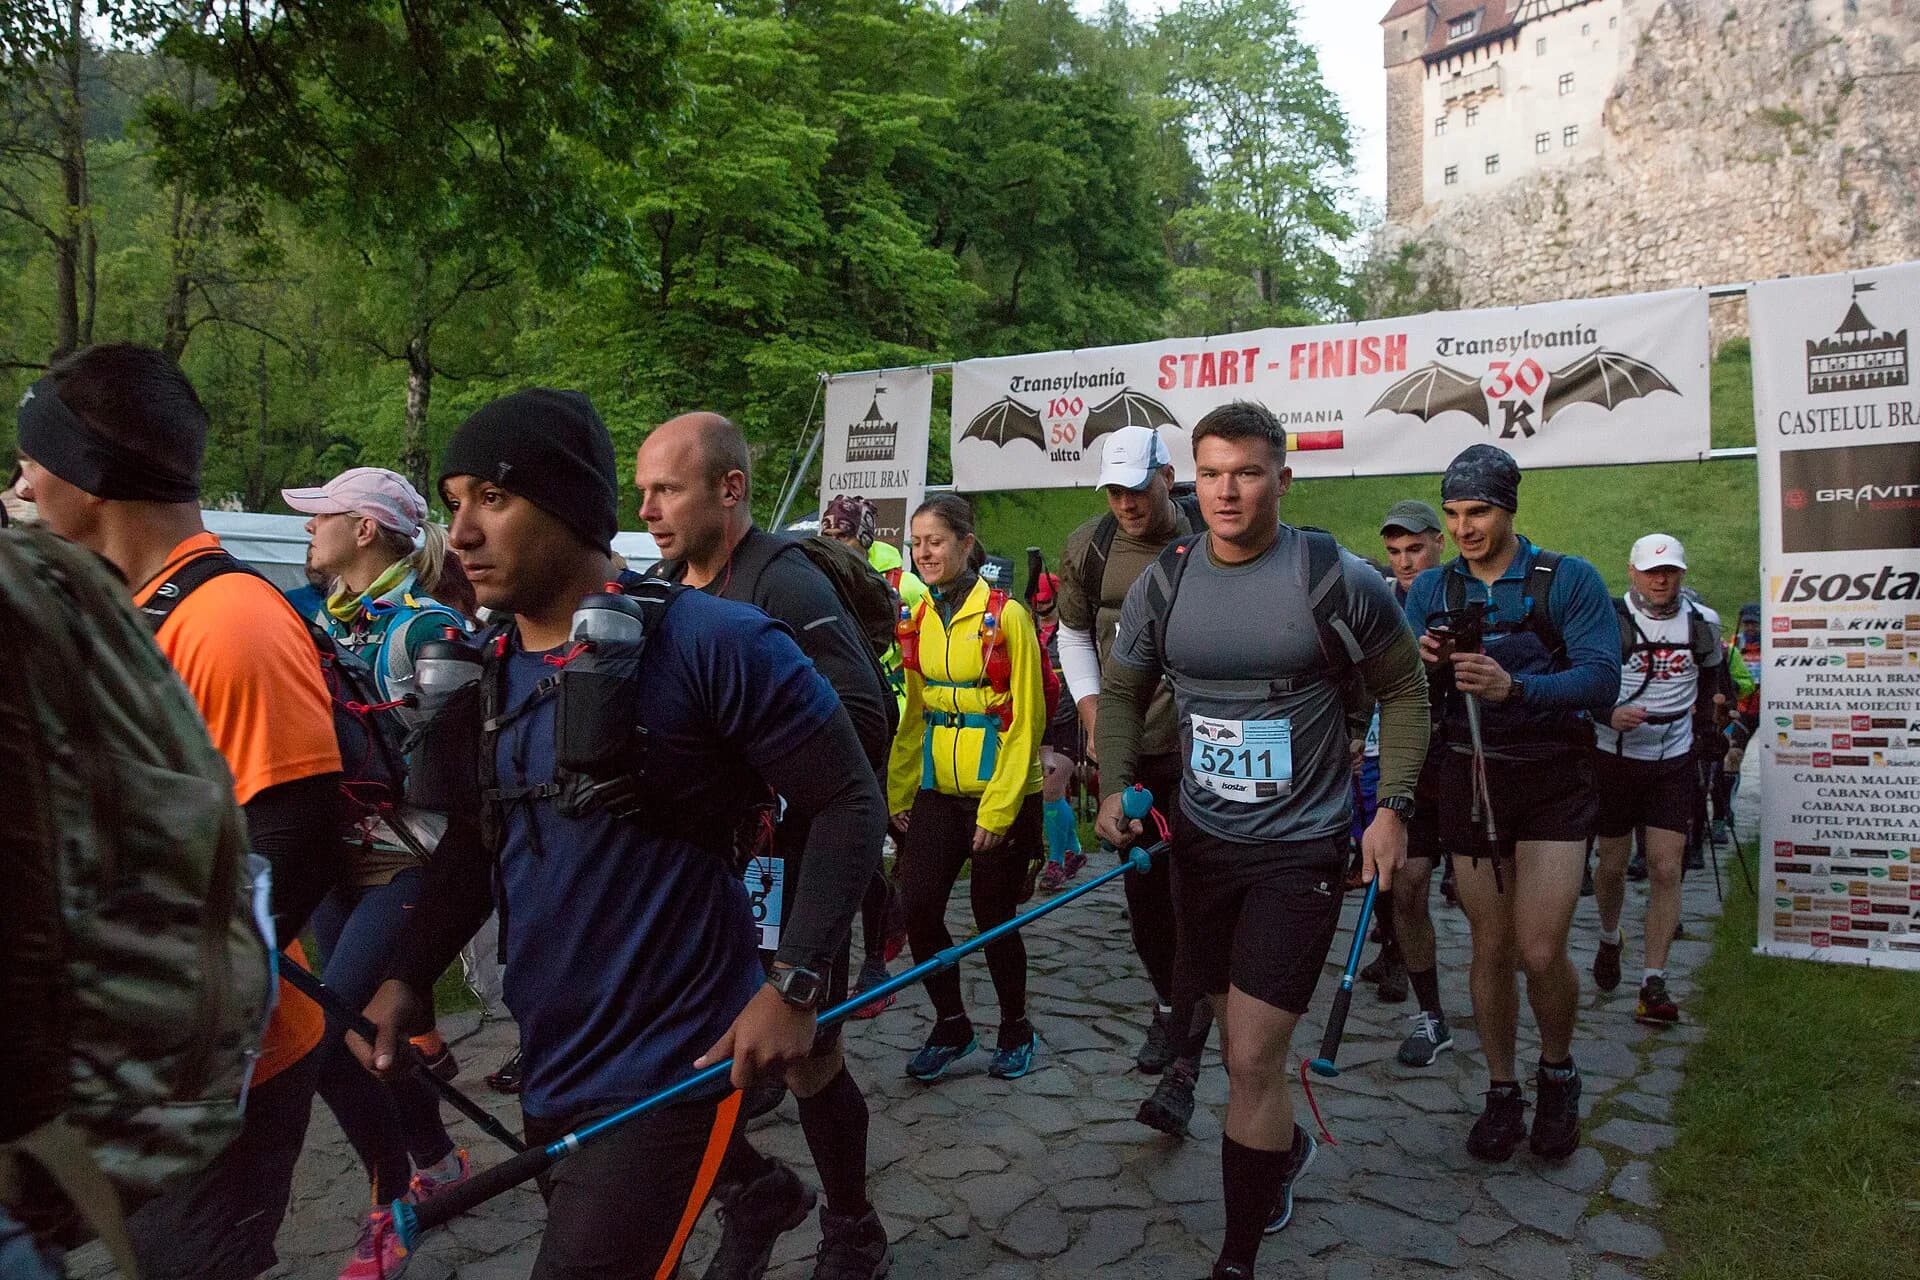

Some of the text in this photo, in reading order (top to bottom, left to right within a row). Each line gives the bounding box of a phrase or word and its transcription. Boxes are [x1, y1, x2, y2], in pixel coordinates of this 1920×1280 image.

[1436, 323, 1598, 357] Transylvania
[1158, 347, 1260, 390] START
[1289, 333, 1408, 380] FINISH
[1010, 367, 1126, 395] Transylvania
[1485, 357, 1544, 399] 30
[1047, 396, 1083, 419] 100
[1276, 409, 1343, 425] OMANIA
[1499, 400, 1536, 439] K
[1778, 403, 1882, 435] CASTELUL
[1050, 423, 1077, 445] 50
[1050, 448, 1081, 462] ultra
[829, 469, 910, 490] CASTELUL BRAN
[1848, 620, 1904, 631] KING
[1774, 657, 1829, 668] KING
[1806, 673, 1882, 683] PRIMARIA
[1796, 687, 1872, 697] PRIMARIA
[1767, 701, 1841, 711] PRIMARIA
[1846, 701, 1911, 711] MOIECIU
[1200, 744, 1272, 778] 5211
[1793, 773, 1920, 786] CABANA MALAIE
[1817, 788, 1920, 800] CABANA OMU
[1801, 801, 1920, 814] CABANA BOLBO
[1791, 814, 1843, 825] HOTEL
[1846, 816, 1904, 828] PIATRA
